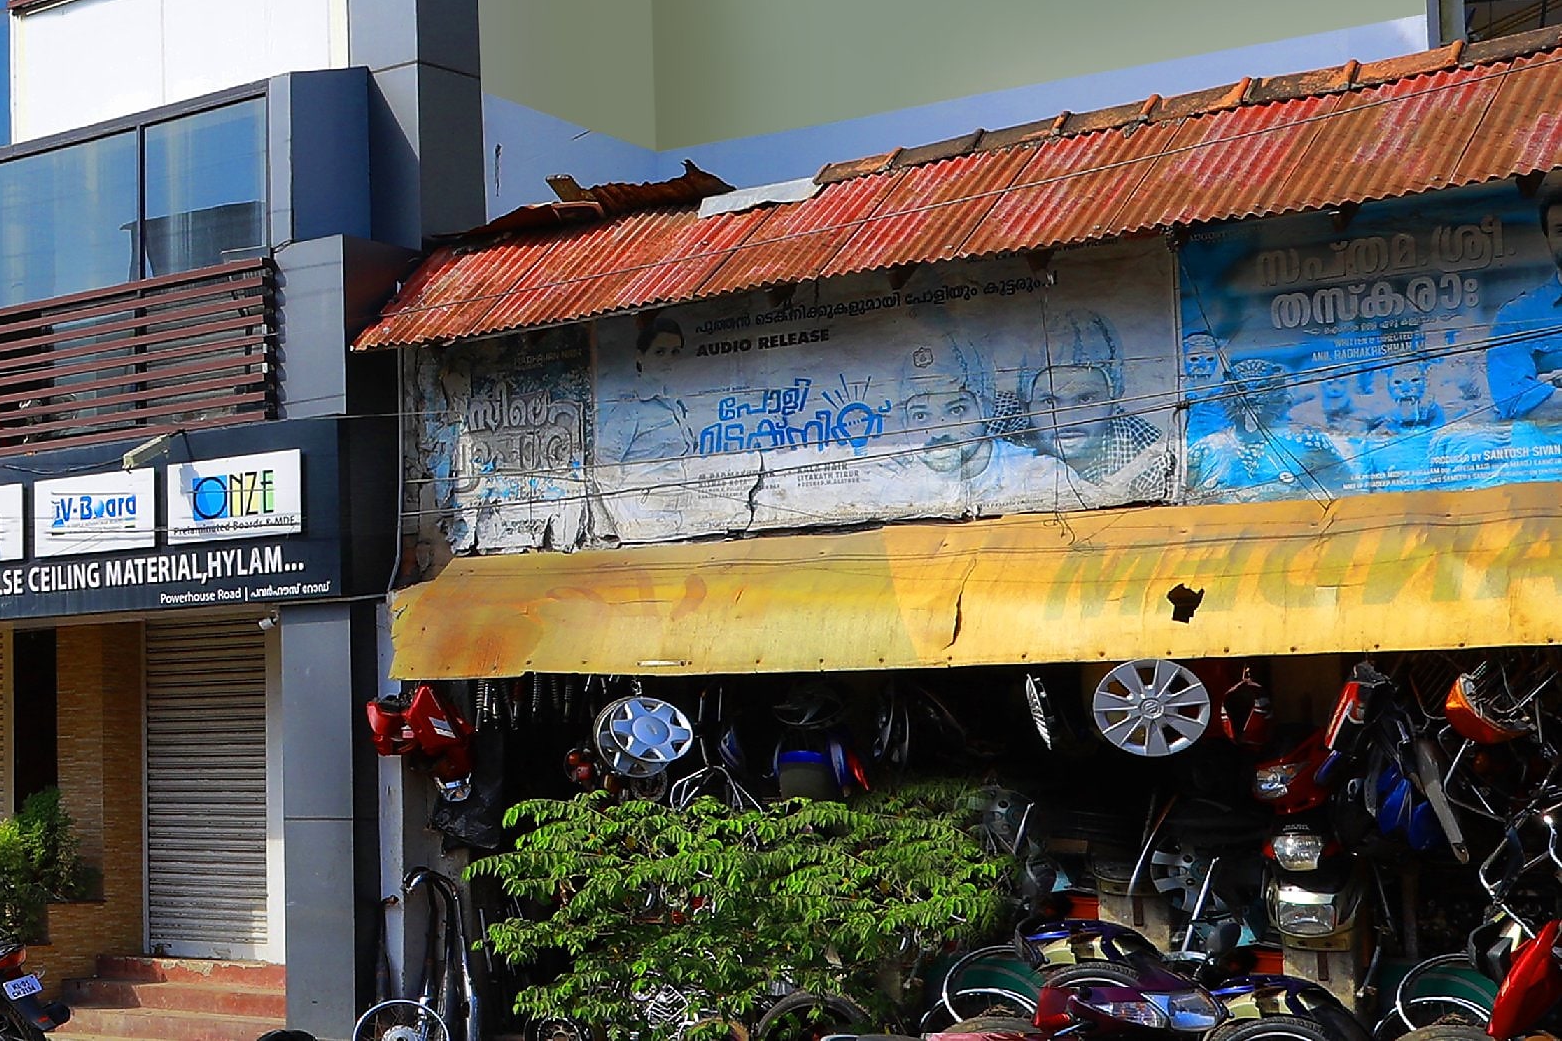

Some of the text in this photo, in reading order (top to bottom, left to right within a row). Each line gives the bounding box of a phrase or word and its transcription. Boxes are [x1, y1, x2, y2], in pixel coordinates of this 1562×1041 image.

[696, 329, 830, 357] AUDIO RELEASE
[1483, 446, 1530, 462] SANTOSH
[1532, 443, 1562, 457] SIVAN
[193, 469, 275, 520] ONZE
[27, 562, 101, 593] CEILING
[160, 586, 242, 605] Powerhouse Road
